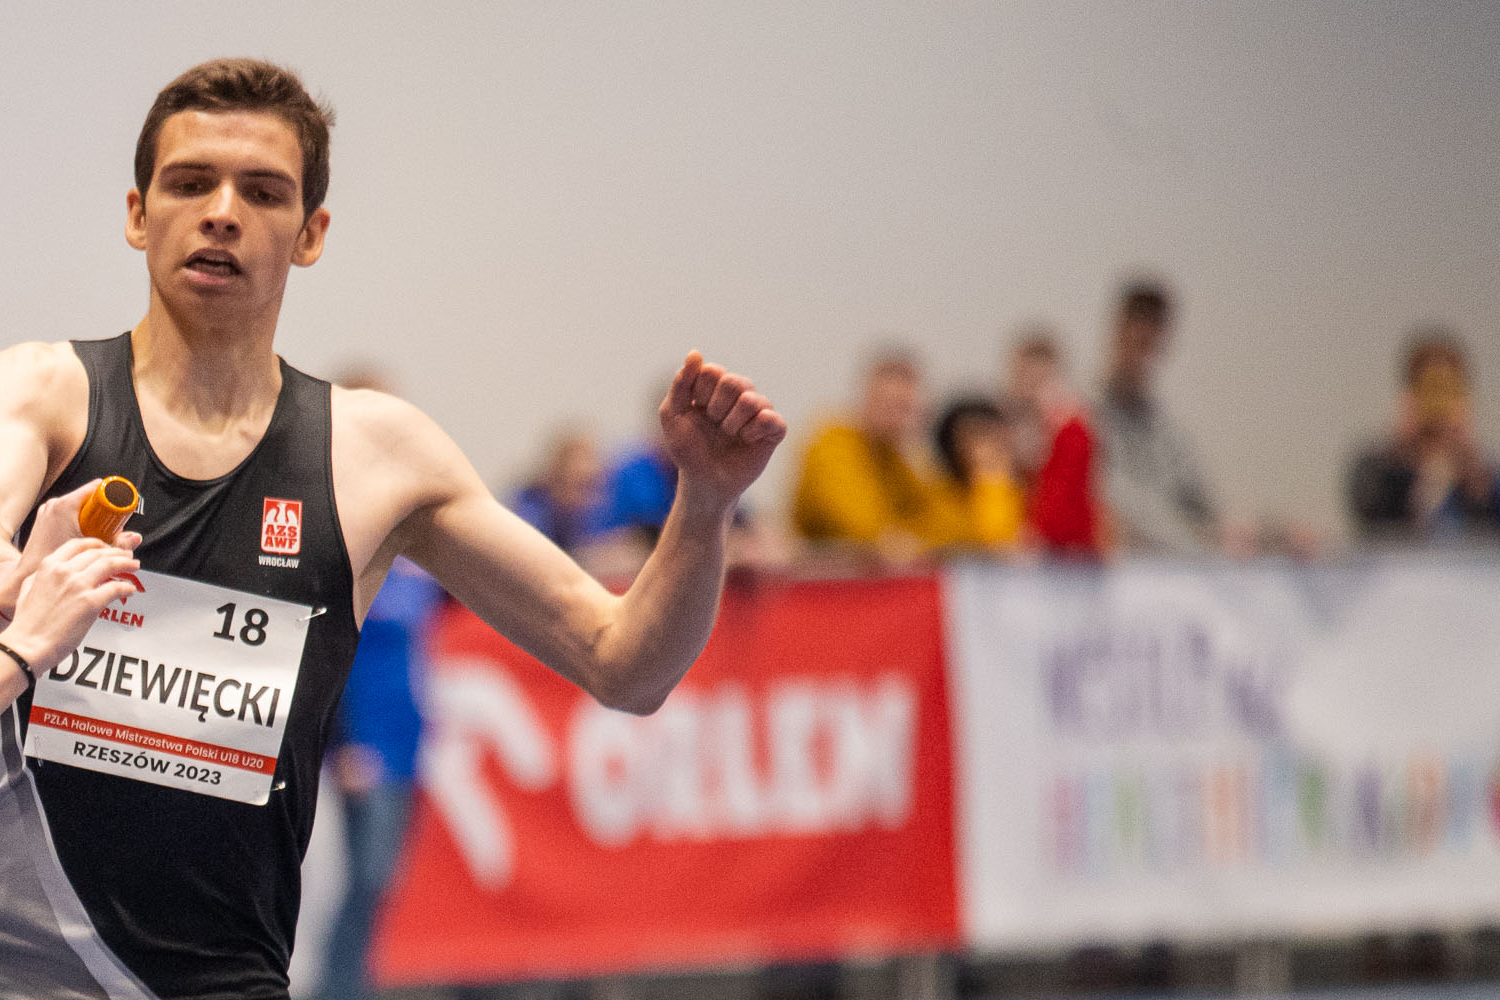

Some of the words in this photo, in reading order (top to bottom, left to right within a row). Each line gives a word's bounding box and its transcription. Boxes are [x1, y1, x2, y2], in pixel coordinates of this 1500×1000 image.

[264, 536, 298, 549] AWF
[265, 524, 298, 538] AZS
[99, 607, 145, 629] RLEN
[212, 602, 270, 647] 18
[48, 646, 282, 728] DZIEWIĘCKI
[43, 712, 70, 728] PZLA
[70, 720, 114, 738] Halowe
[115, 728, 184, 753] Mistrzostwa
[185, 743, 219, 761] Polski
[220, 752, 240, 765] U18
[241, 756, 265, 770] U20
[72, 740, 171, 775] RZESZÓW
[173, 762, 223, 786] 2023
